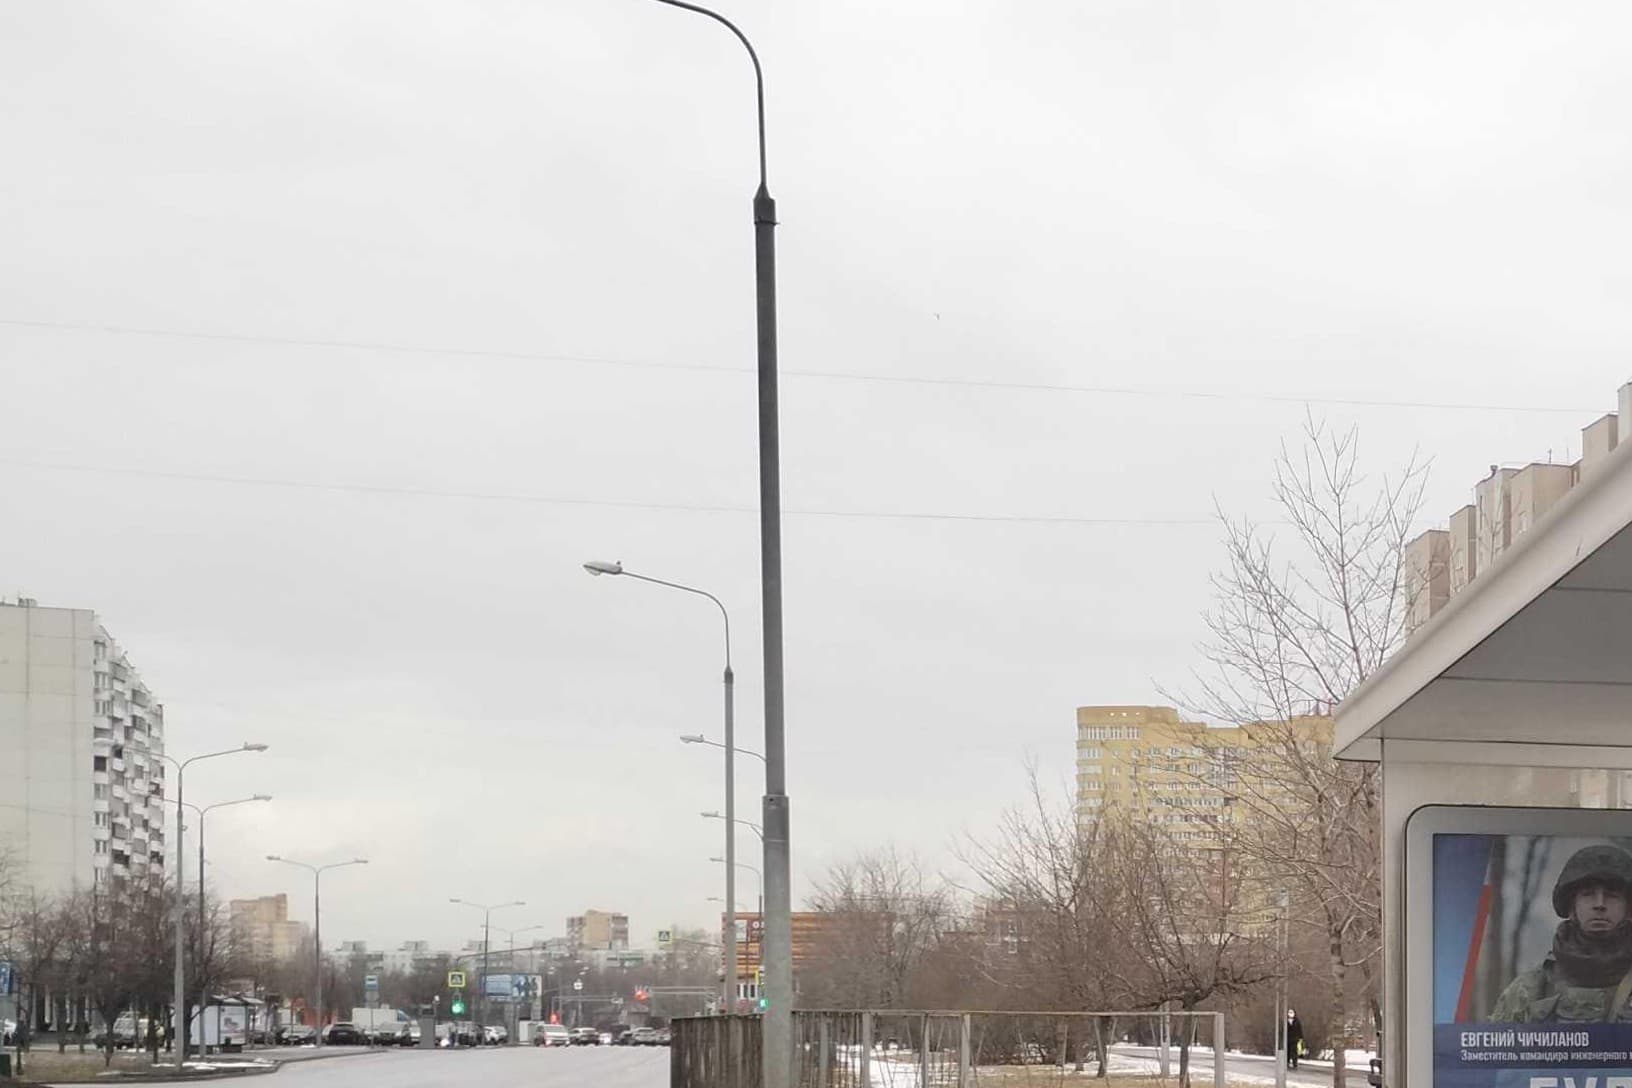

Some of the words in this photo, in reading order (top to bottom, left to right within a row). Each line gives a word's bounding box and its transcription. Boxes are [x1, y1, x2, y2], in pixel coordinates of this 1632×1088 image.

[1460, 1029, 1516, 1047] ЕВГЕНИЙ
[1517, 1031, 1590, 1047] ЧИЧИЛАНОВ
[1461, 1050, 1519, 1062] Заместитель
[1519, 1051, 1569, 1063] командира
[1570, 1051, 1627, 1063] инженерного
